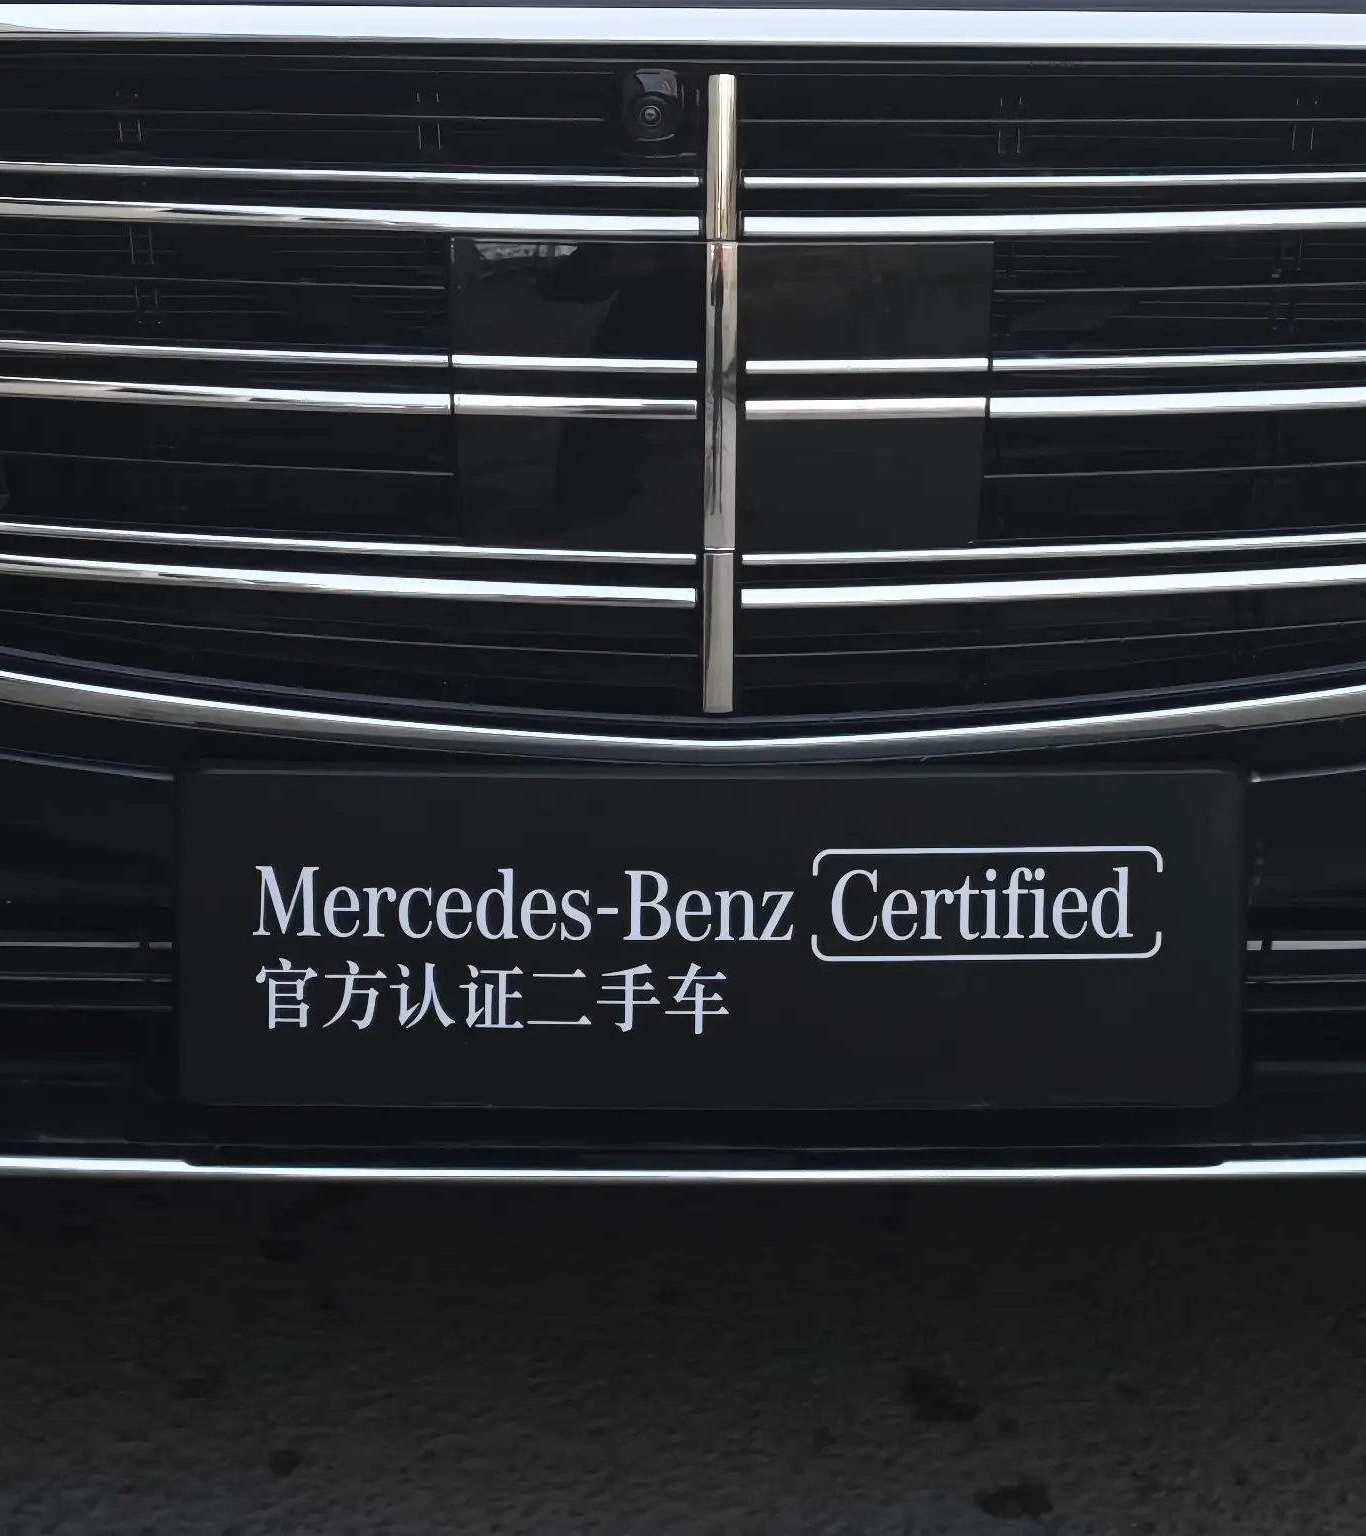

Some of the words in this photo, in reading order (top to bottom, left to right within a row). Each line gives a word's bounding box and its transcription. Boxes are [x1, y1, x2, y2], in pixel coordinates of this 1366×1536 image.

[252, 865, 795, 942] Mercedes-Benz
[831, 866, 1133, 941] Certified
[255, 957, 730, 1035] 官方认证二手车
